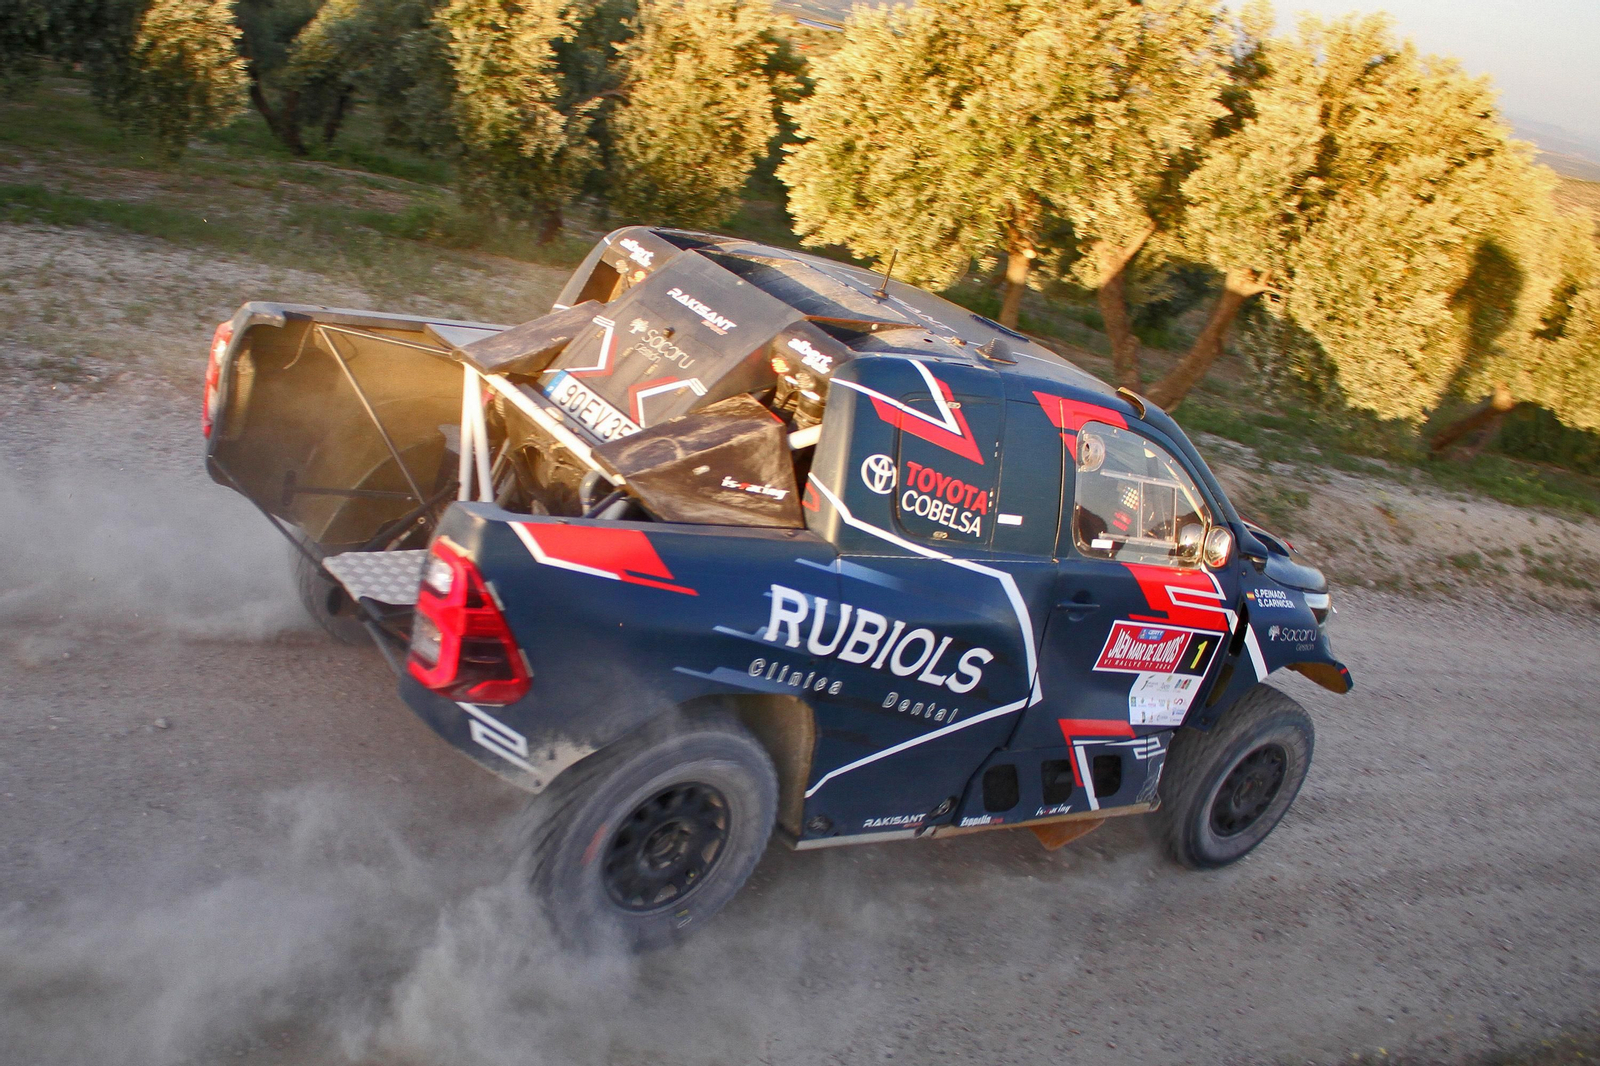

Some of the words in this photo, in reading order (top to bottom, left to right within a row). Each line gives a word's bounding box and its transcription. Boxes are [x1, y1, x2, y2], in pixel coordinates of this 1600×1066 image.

[666, 287, 738, 330] RAKISANT
[906, 461, 989, 515] TOYOTA
[901, 489, 982, 538] COBELSA
[762, 583, 995, 694] RUBIOLS
[1127, 639, 1146, 661] MAR
[1142, 642, 1157, 661] DE
[1152, 633, 1185, 663] OLIVOS
[1190, 640, 1208, 669] 1
[1114, 659, 1142, 668] RALLYE
[881, 691, 959, 724] Dental
[863, 813, 927, 828] RAKISANT
